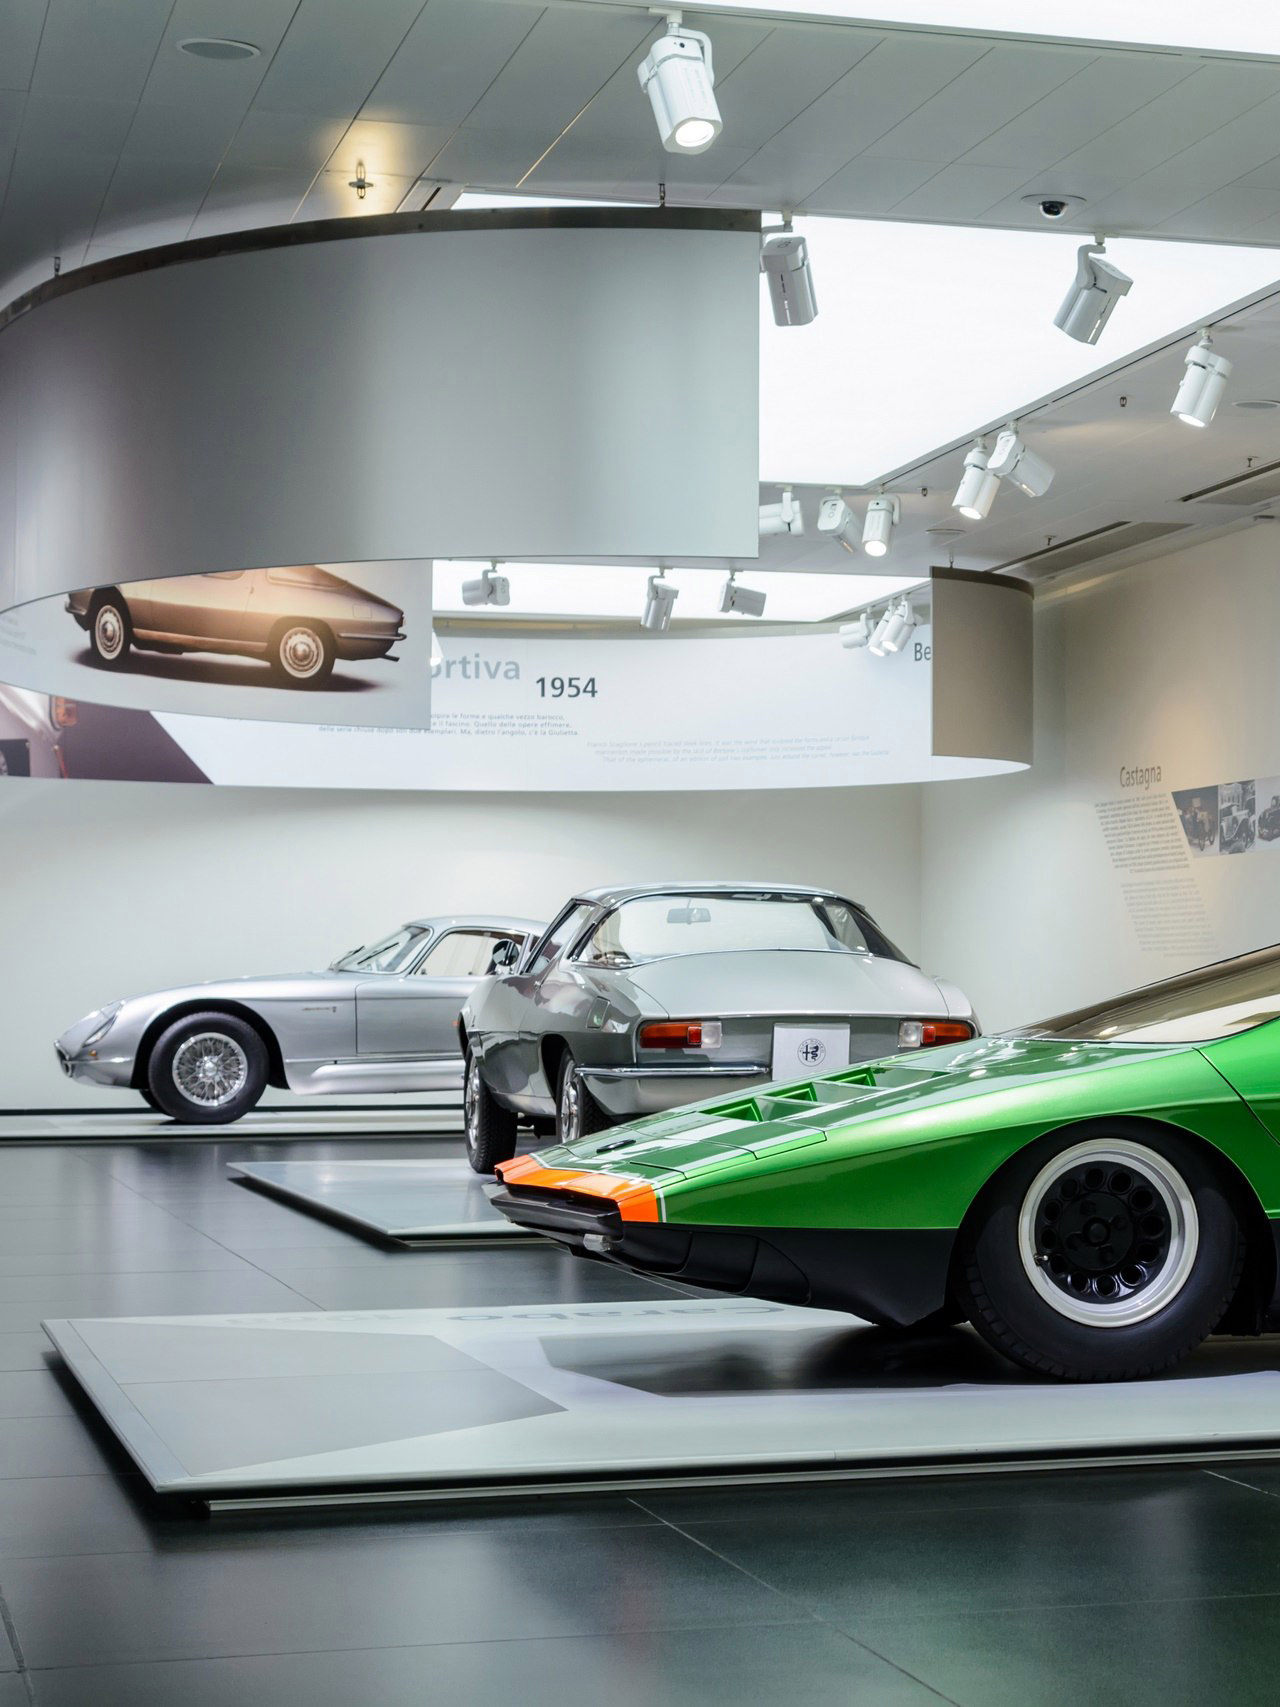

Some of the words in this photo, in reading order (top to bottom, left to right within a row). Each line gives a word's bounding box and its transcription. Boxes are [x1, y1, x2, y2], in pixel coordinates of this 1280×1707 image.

[536, 677, 598, 698] 1954
[1119, 765, 1162, 791] Castagna
[445, 1306, 786, 1321] Carabo
